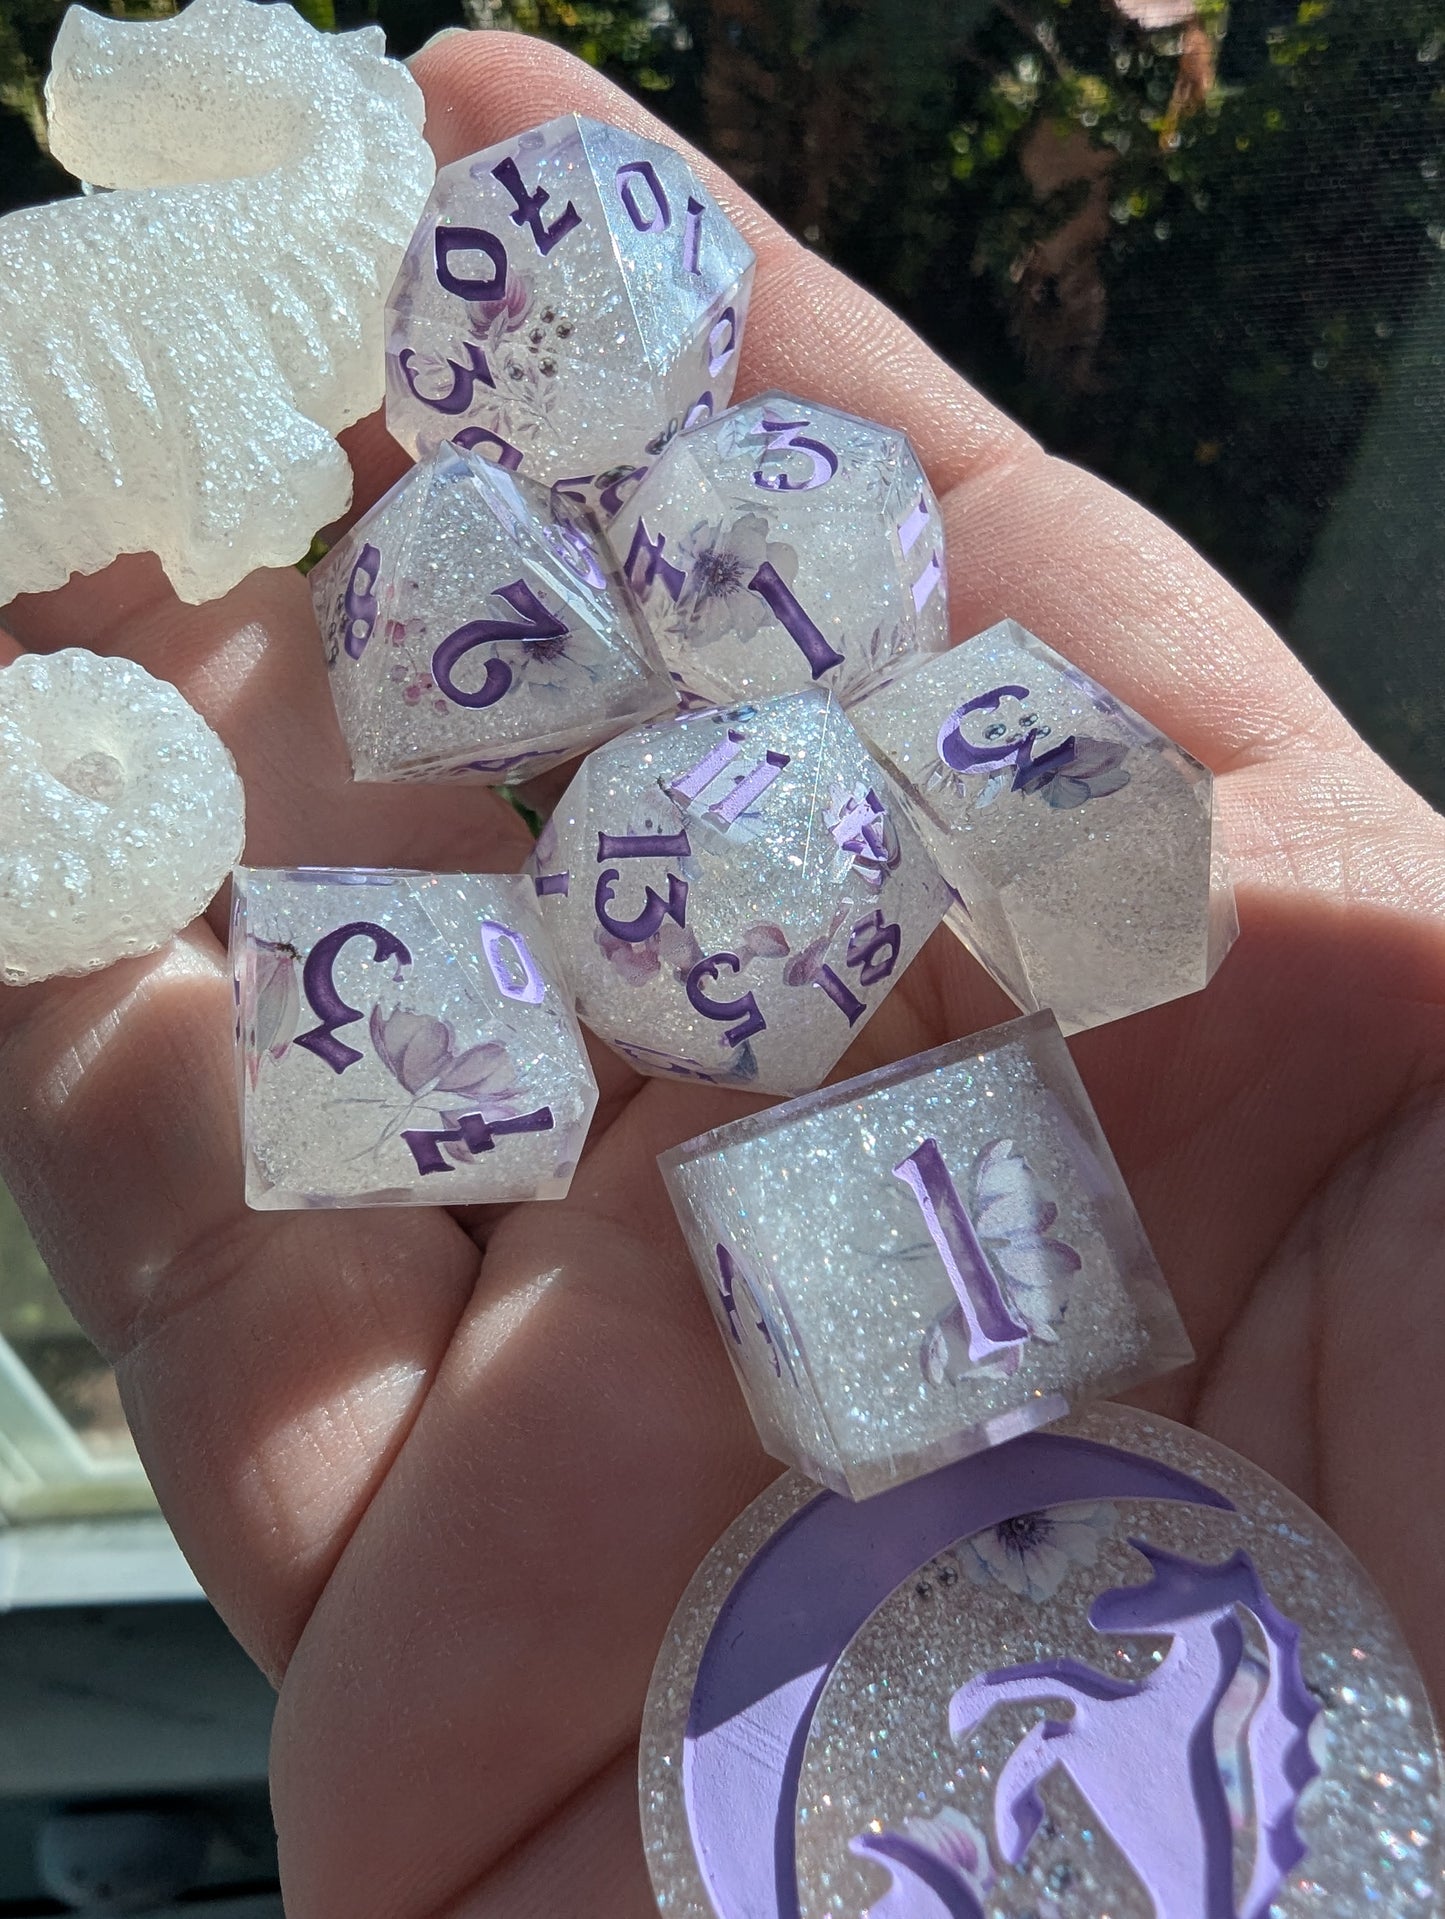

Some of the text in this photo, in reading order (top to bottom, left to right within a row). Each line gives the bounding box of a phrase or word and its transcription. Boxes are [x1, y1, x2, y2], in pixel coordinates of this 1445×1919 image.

[344, 543, 381, 660] 8
[432, 578, 569, 709] 2
[748, 561, 846, 680] 1
[595, 830, 691, 943] 13
[293, 921, 413, 1075] 3
[686, 951, 767, 1048] 5
[892, 1138, 1028, 1362] 1
